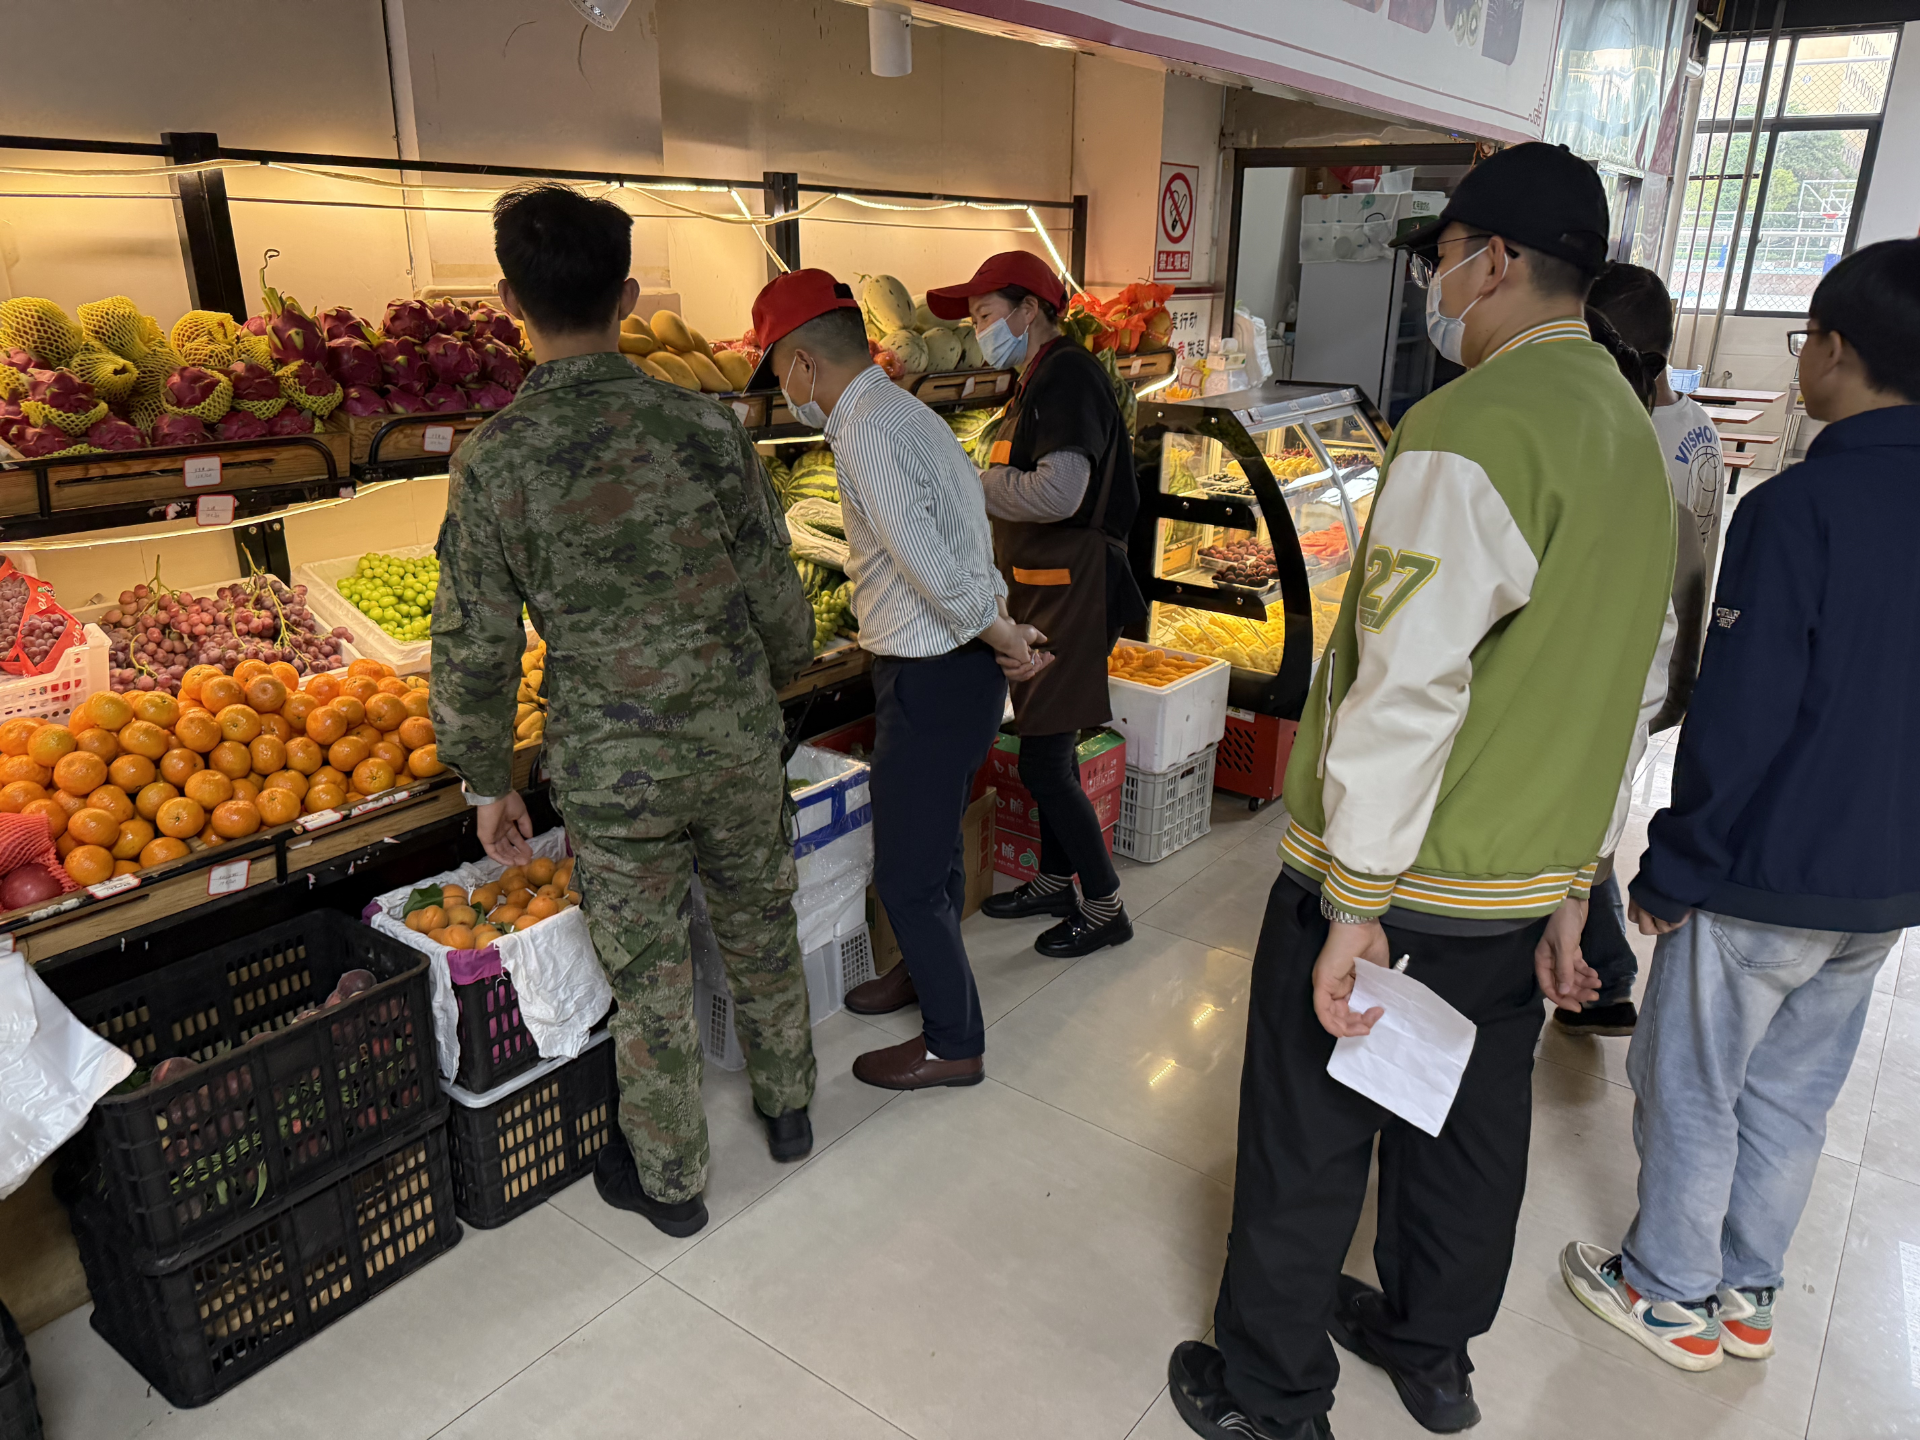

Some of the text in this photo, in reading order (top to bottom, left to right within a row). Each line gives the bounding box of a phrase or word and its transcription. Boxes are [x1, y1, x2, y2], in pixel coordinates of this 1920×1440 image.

[1159, 253, 1189, 270] 禁止吸烟
[1359, 544, 1442, 635] 27
